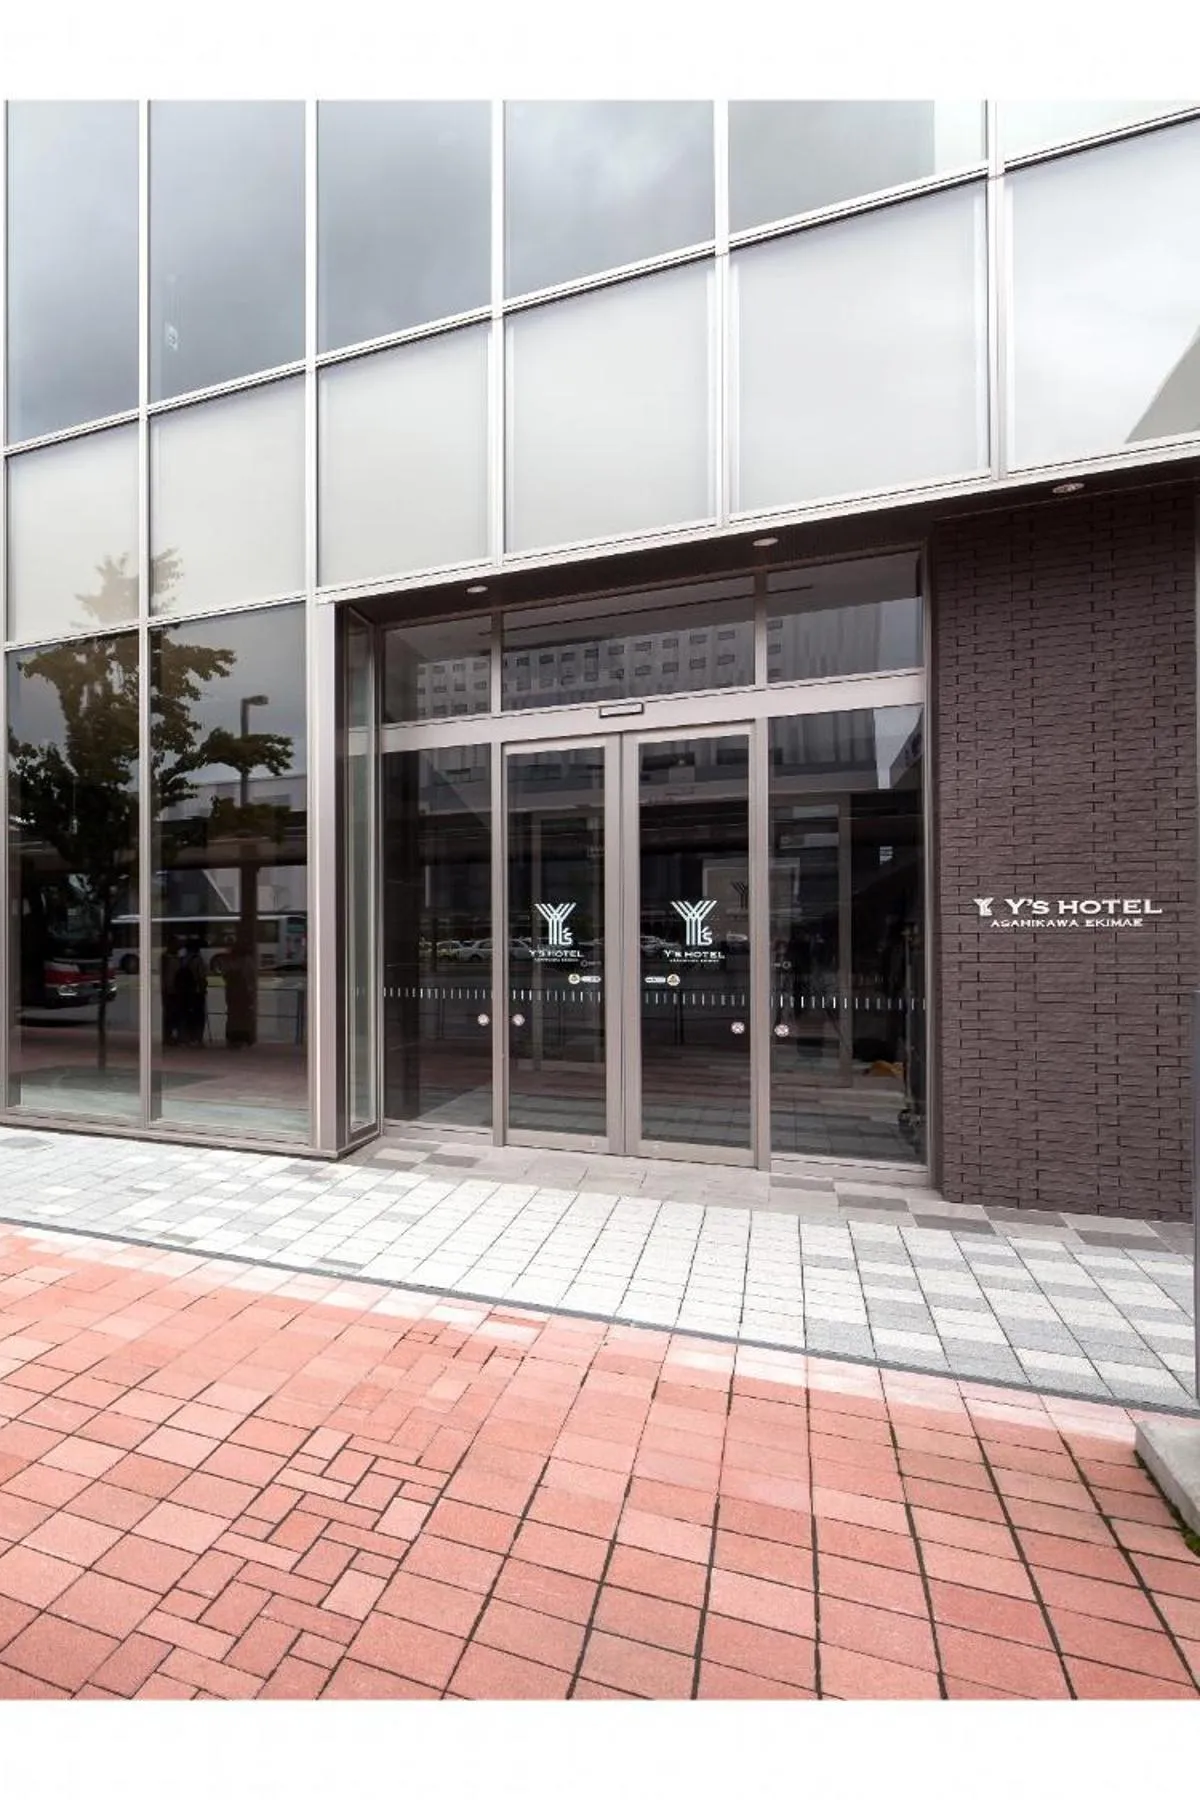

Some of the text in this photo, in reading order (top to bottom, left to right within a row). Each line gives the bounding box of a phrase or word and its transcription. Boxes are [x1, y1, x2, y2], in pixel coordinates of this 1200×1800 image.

[1057, 899, 1163, 915] HOTEL
[1085, 918, 1143, 928] EKIMAE
[547, 949, 585, 958] HOTEL
[684, 951, 725, 959] HOTEL
